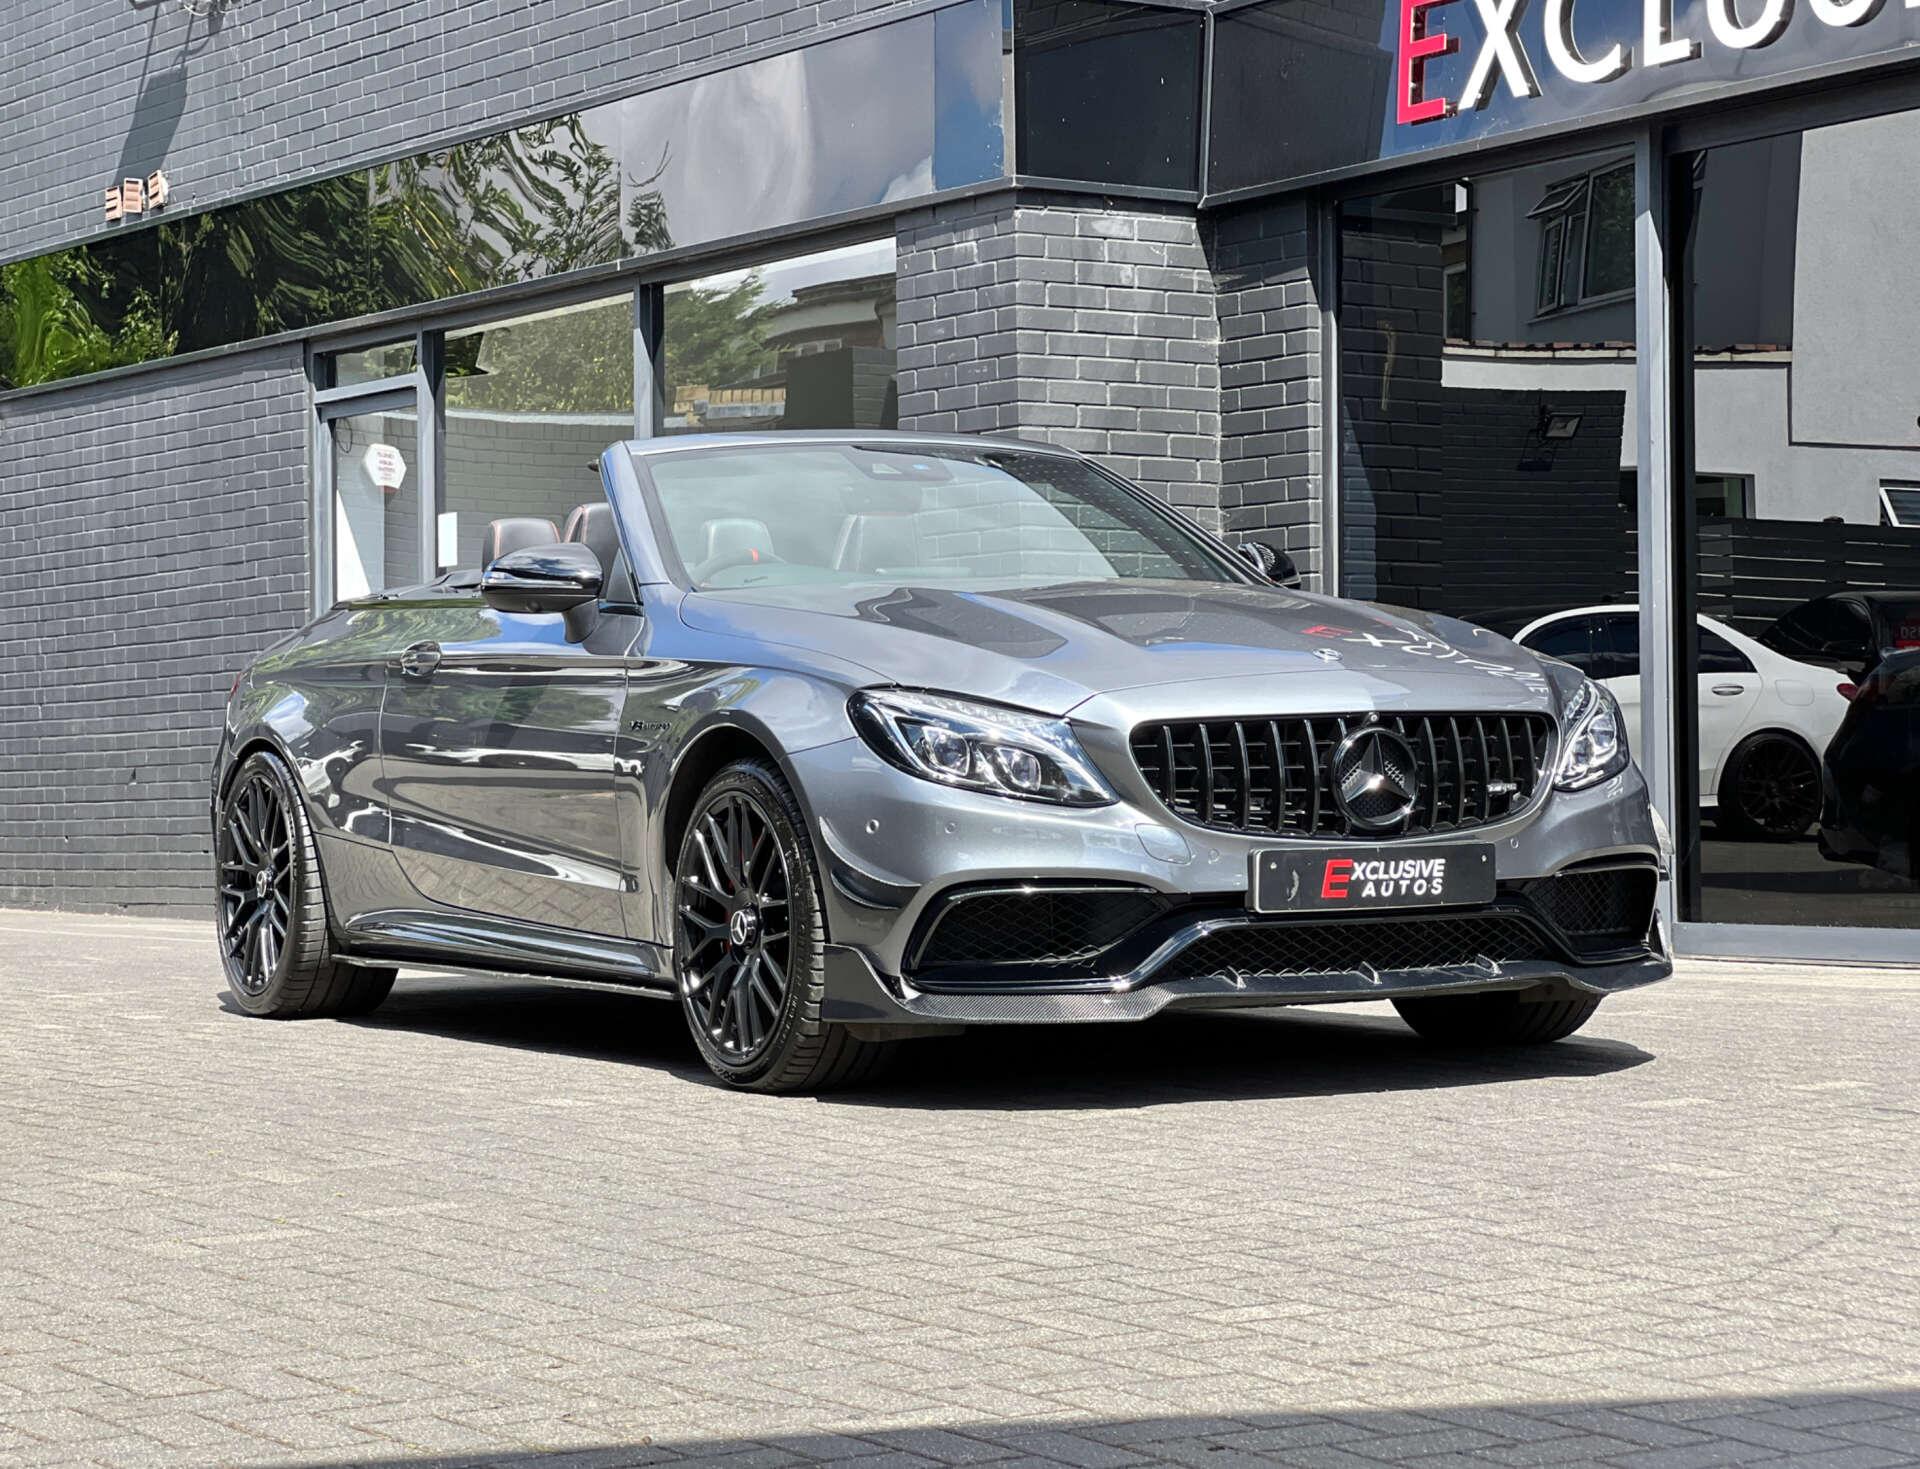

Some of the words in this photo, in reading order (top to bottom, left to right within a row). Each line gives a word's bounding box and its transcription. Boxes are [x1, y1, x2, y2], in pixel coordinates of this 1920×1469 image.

[1397, 0, 1920, 124] EXCL
[1321, 858, 1446, 898] EXCLUSIVE
[1361, 877, 1443, 898] AUTOS
